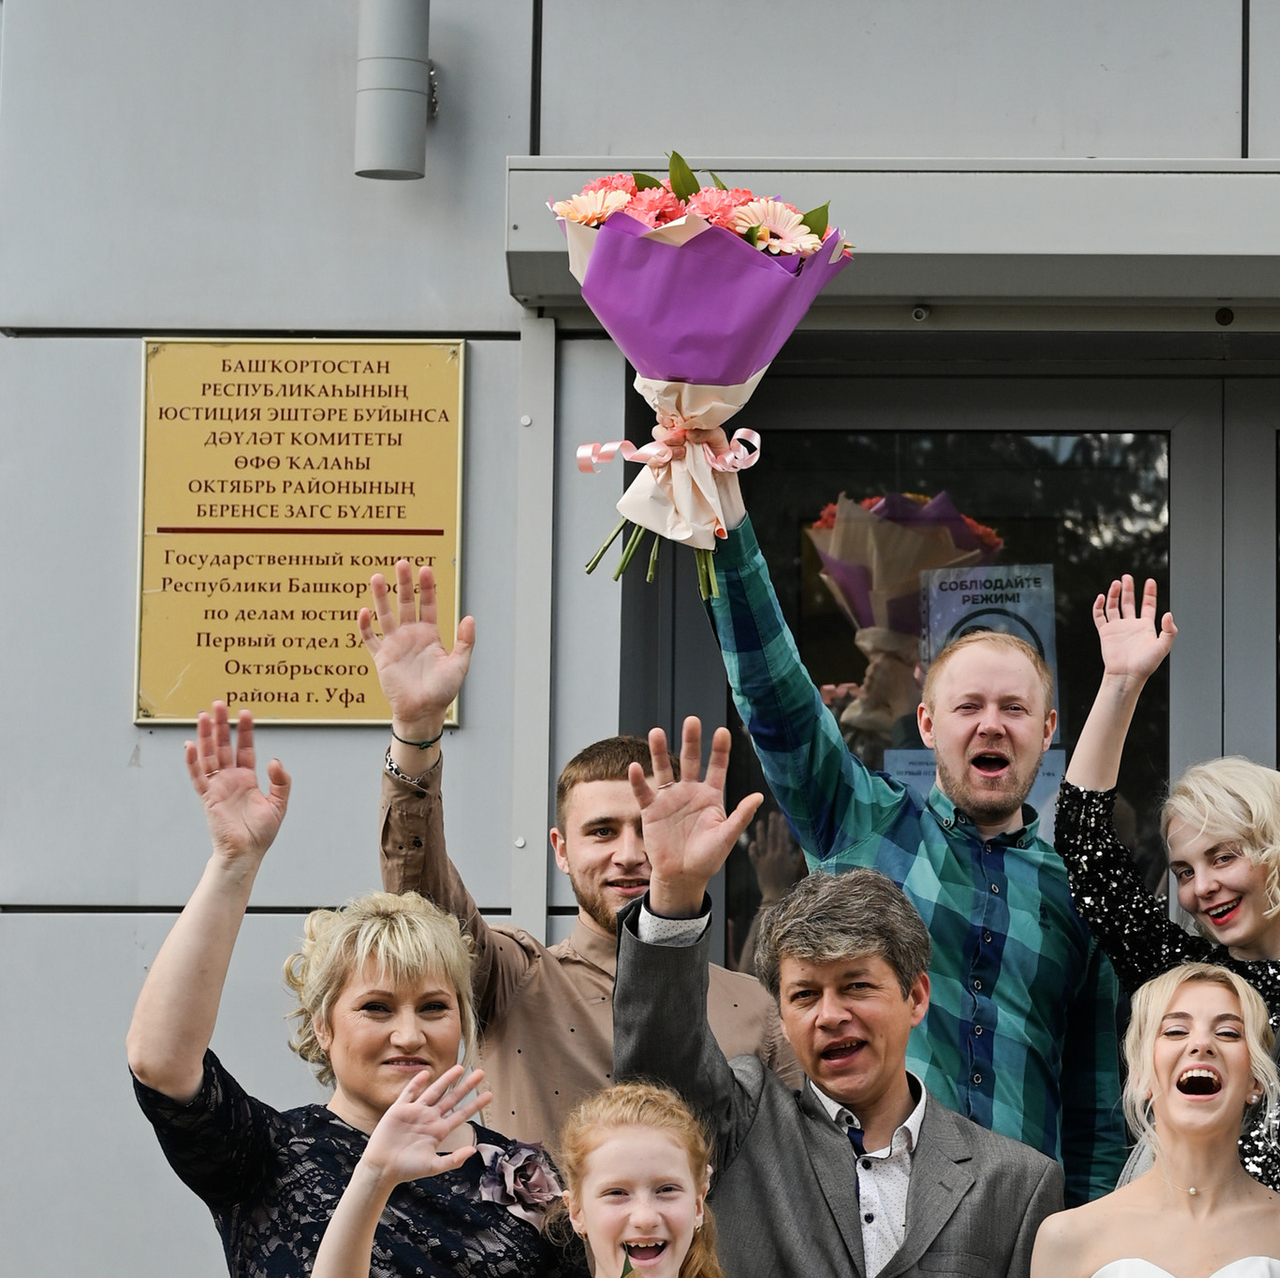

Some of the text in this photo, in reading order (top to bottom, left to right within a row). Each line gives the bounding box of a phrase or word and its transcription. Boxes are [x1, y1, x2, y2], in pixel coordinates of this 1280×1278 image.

[221, 358, 390, 375] БАШҠОРТОСТАН
[158, 405, 450, 424] ЮСТИЦИЯ ЭШТӘРЕ БУЙЫНСА
[203, 431, 403, 447] ДӘҮЛӘТ КОМИТЕТЫ
[234, 455, 281, 470] ӨФӨ
[188, 477, 416, 497] ОКТЯБРЬ РАЙОНЫНЫҢ
[196, 503, 407, 520] БЕРЕНСЕ ЗАГС БҮЛЕГЕ
[164, 549, 344, 570] Государственный
[161, 576, 282, 598] Республики
[938, 576, 1042, 592] СОБЛЮДАЙТЕ
[961, 593, 1021, 605] РЕЖИМ!
[203, 609, 229, 621] по
[234, 609, 295, 623] делам
[196, 631, 276, 653] Первый
[281, 636, 339, 651] отдел
[224, 659, 369, 681] Октябрьского
[226, 687, 366, 709] района г. Уфа
